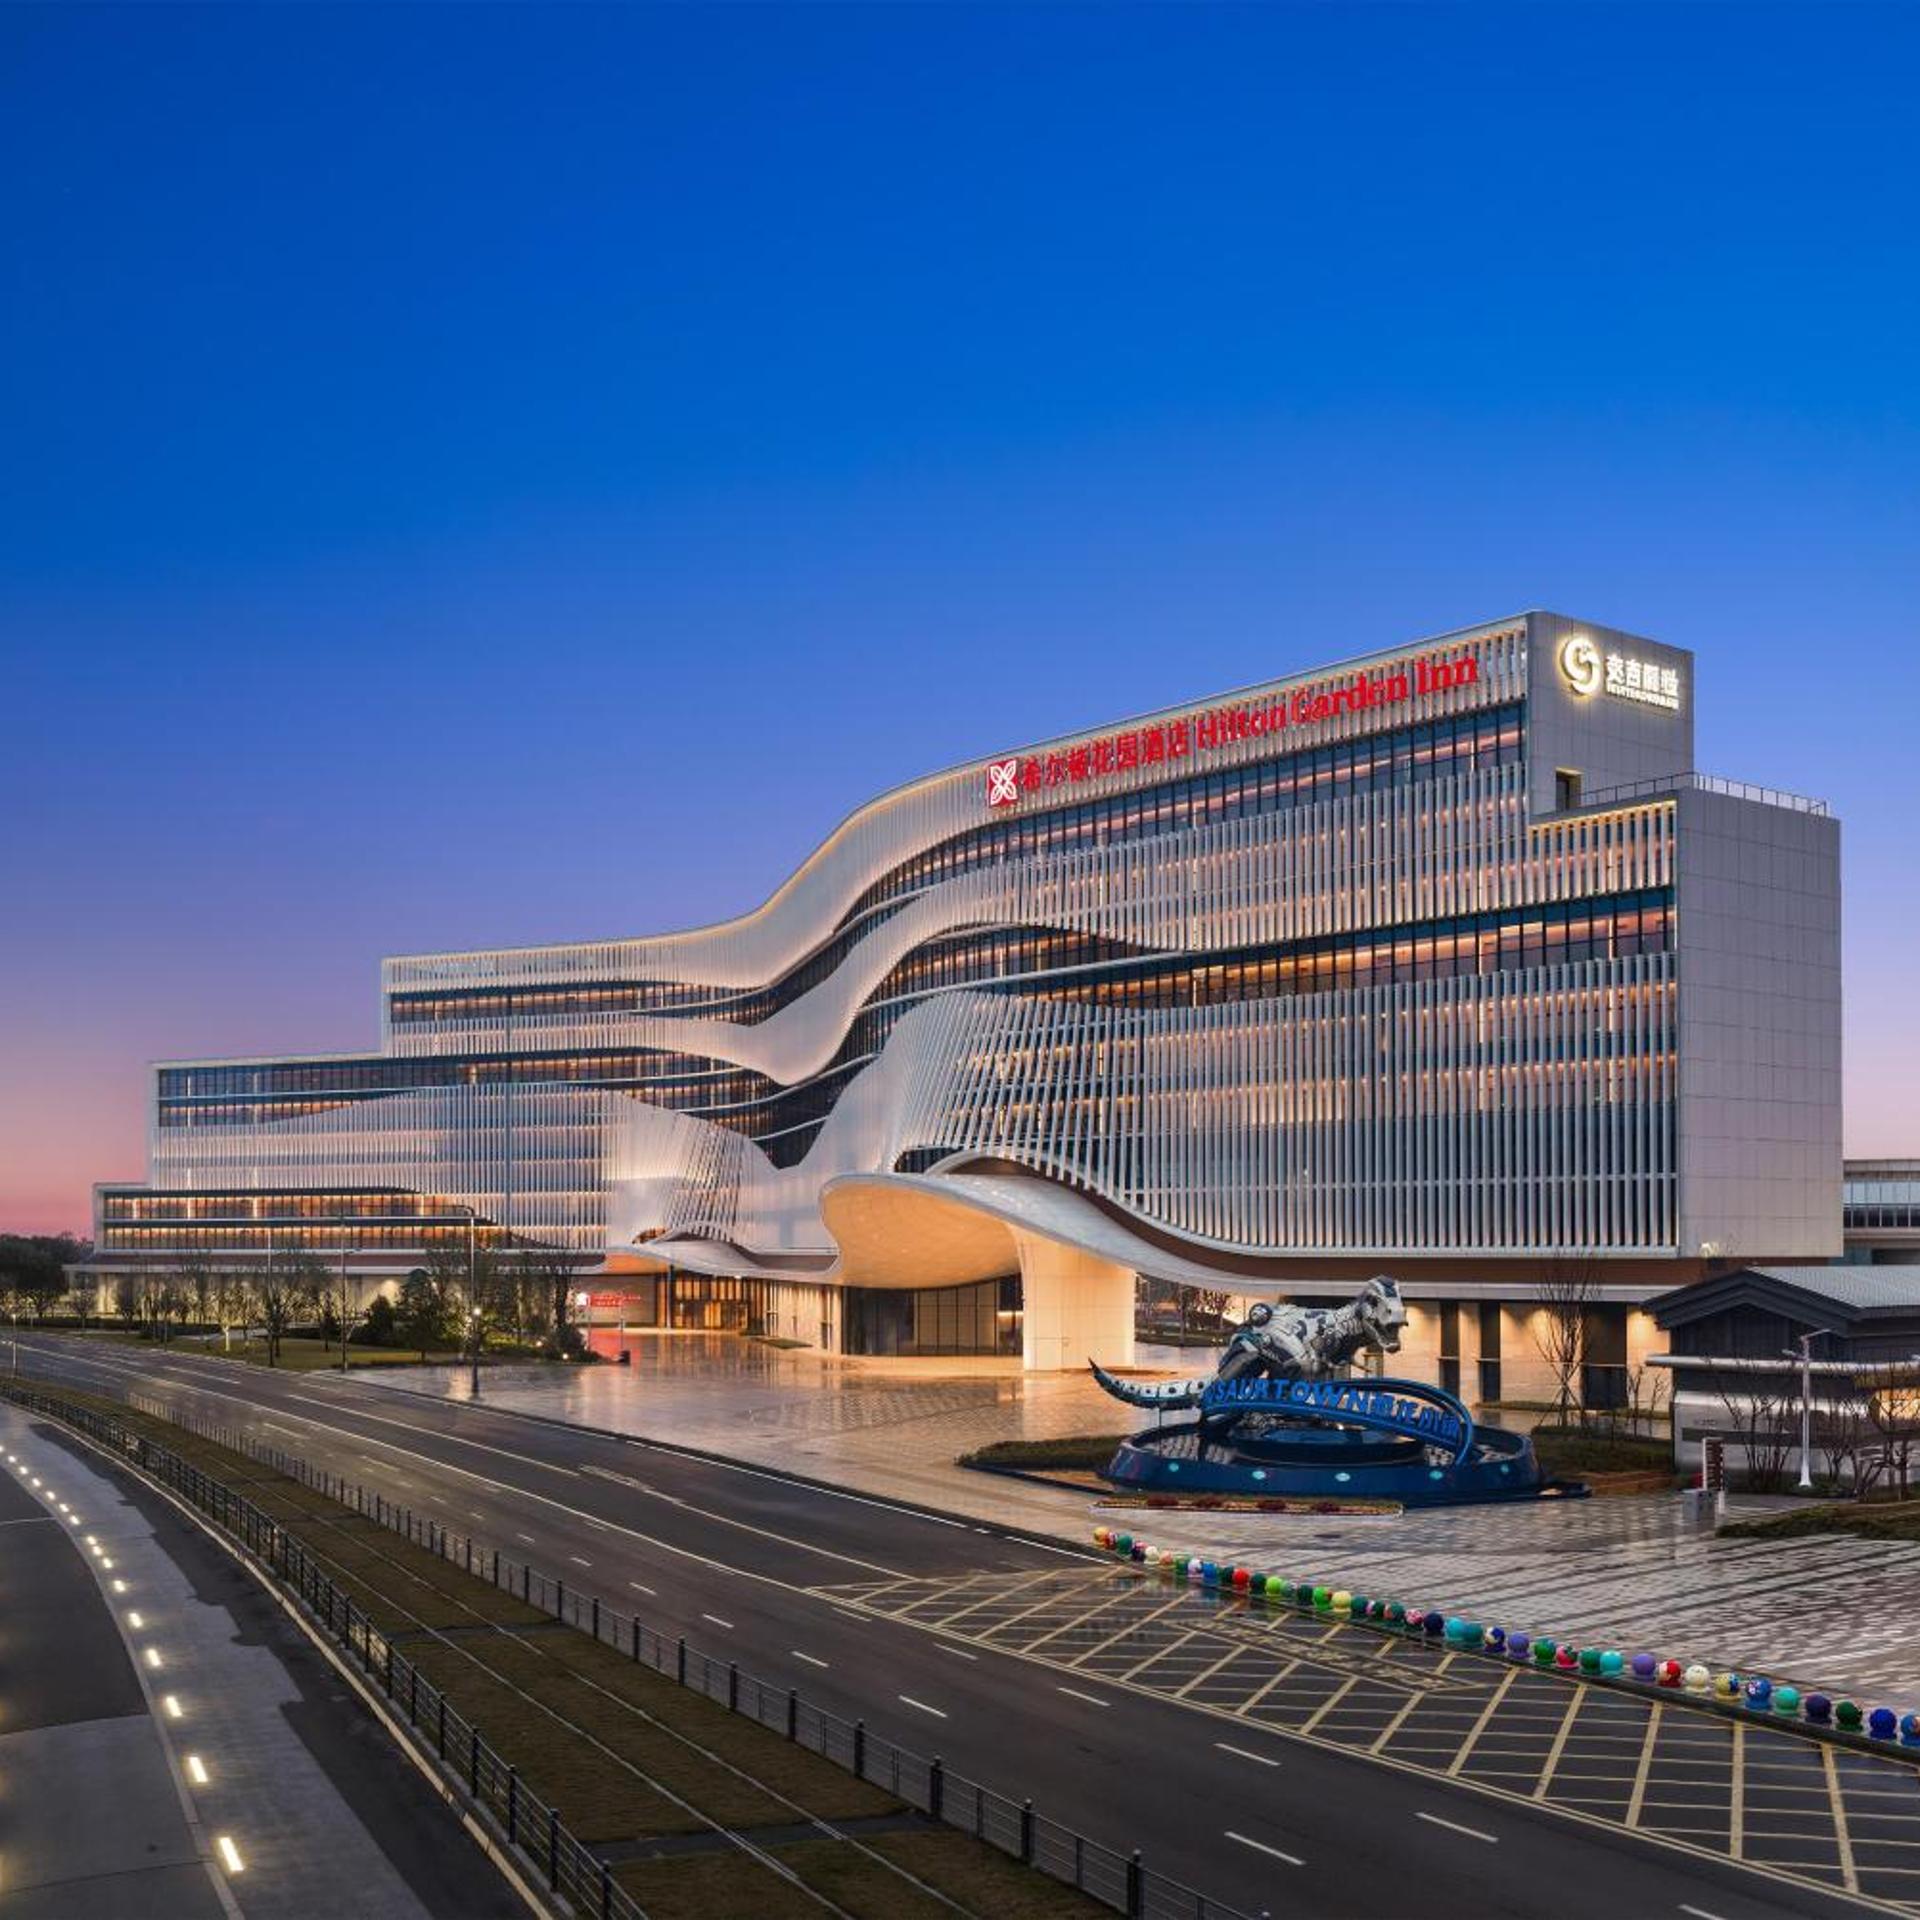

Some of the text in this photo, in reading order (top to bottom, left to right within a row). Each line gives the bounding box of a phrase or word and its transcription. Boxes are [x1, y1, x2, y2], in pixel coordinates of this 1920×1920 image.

[1197, 657, 1477, 749] Hilton Garden Inn
[1023, 720, 1188, 791] 希尔顿花园酒店
